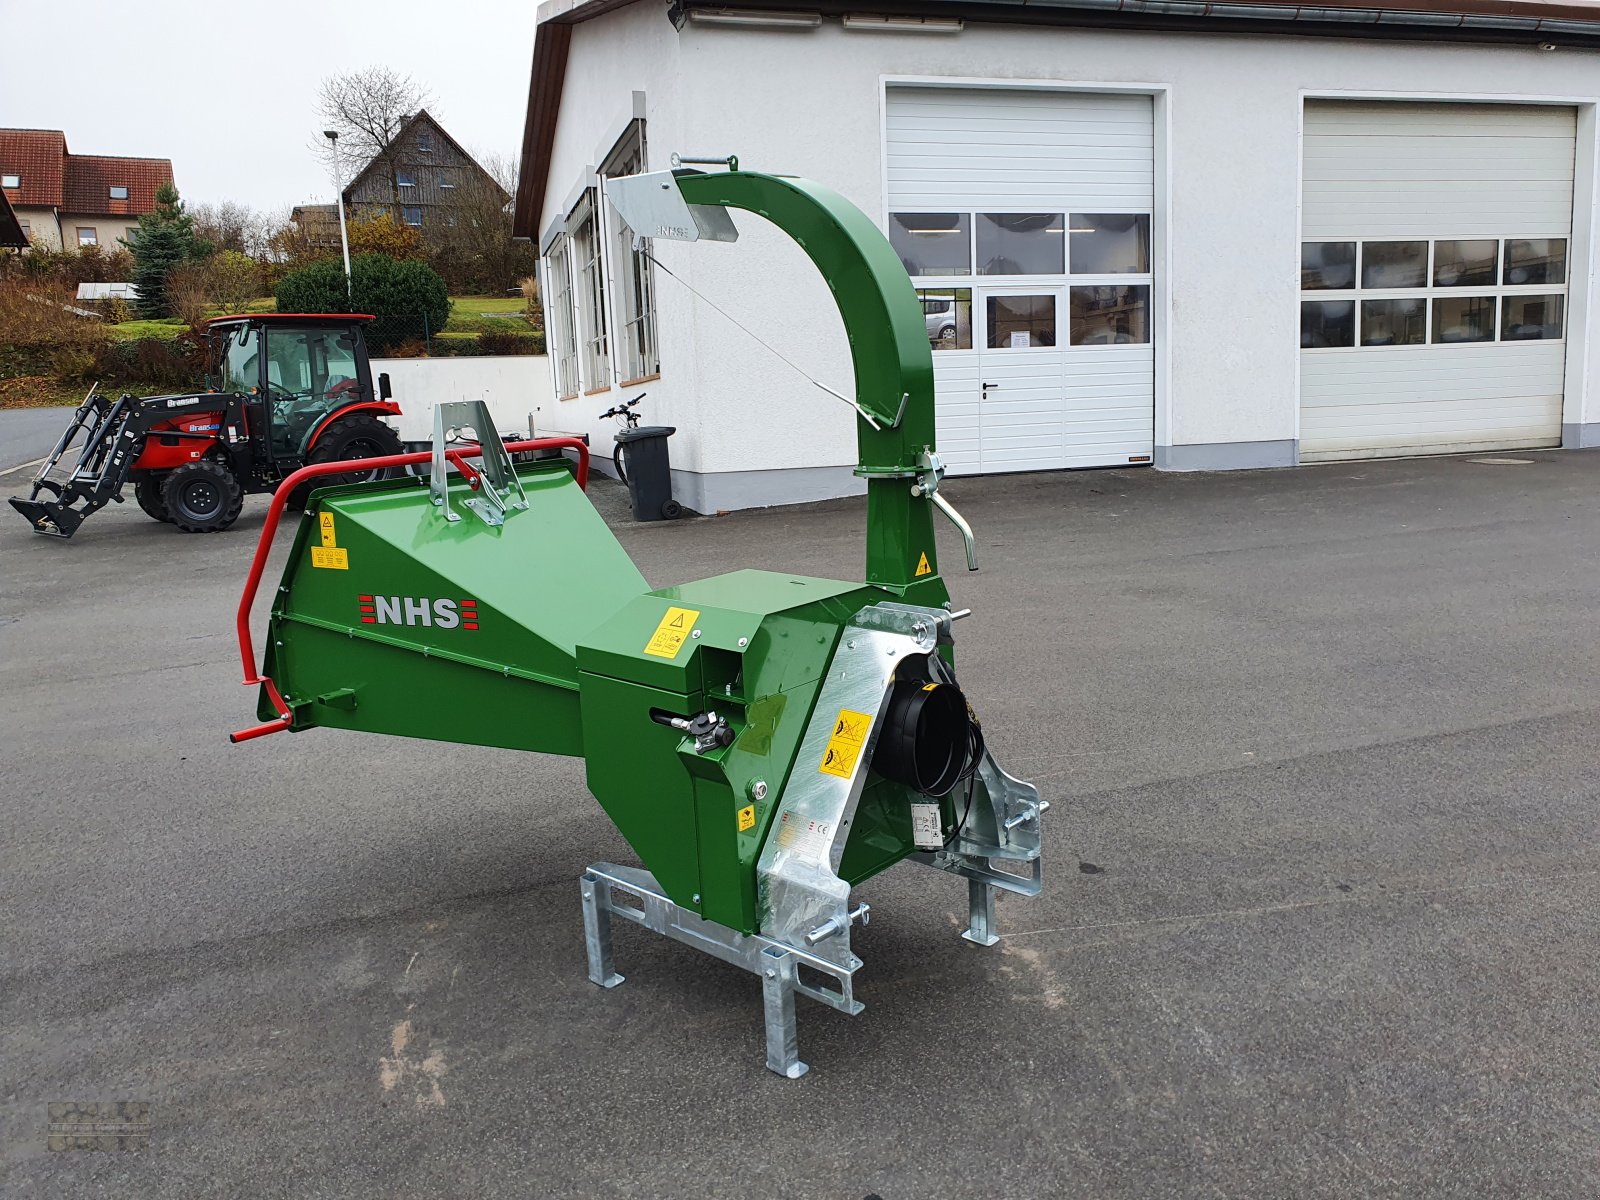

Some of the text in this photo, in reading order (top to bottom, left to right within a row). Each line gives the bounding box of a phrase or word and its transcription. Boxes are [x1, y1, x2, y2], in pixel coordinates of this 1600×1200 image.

[660, 226, 684, 237] NHS
[167, 397, 199, 407] Branson
[189, 424, 220, 432] Branson
[117, 450, 124, 458] 15
[374, 595, 460, 629] NHS
